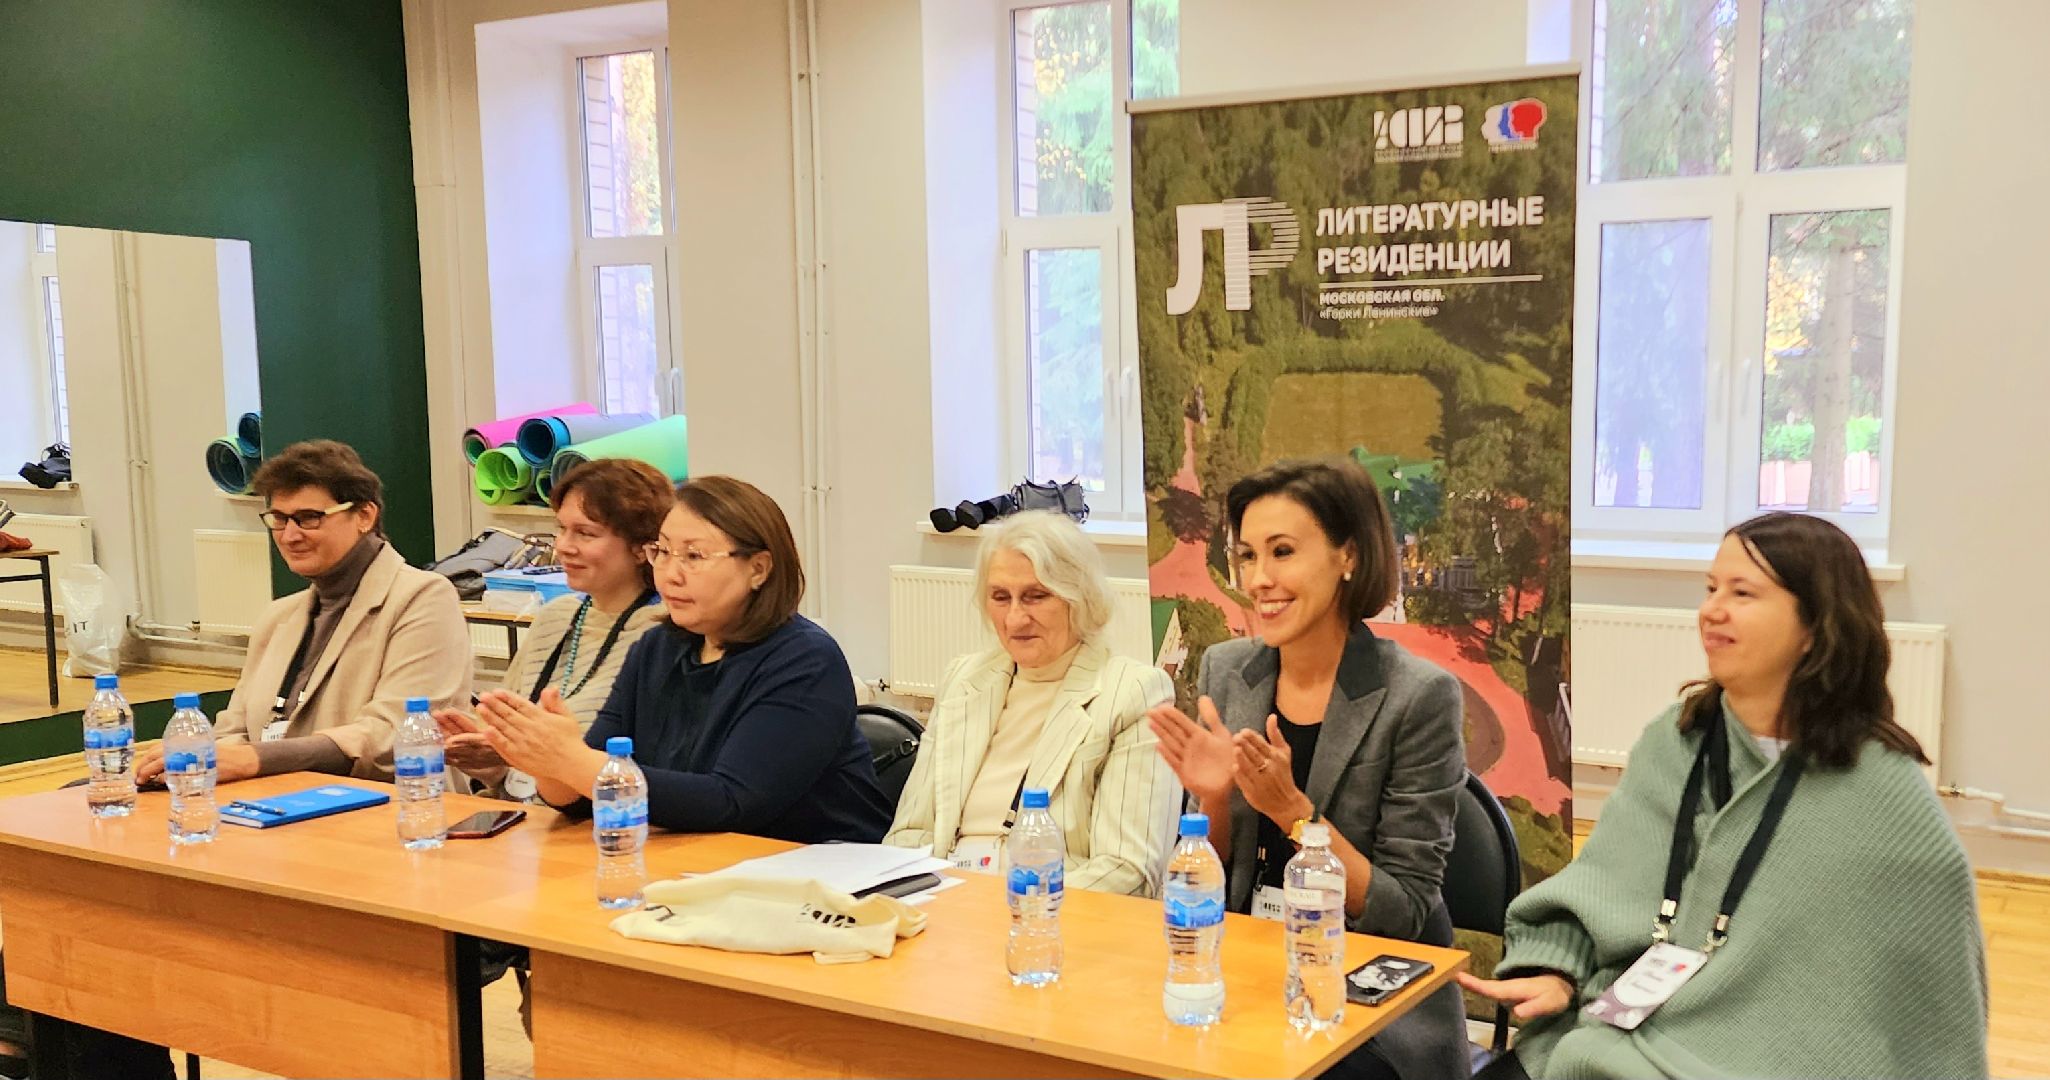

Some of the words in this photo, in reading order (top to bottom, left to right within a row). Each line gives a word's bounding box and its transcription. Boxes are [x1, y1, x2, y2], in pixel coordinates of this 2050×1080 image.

[1315, 195, 1545, 237] ЛИТЕРАТУРНЫЕ
[1316, 238, 1512, 277] РЕЗИДЕНЦИИ
[1319, 289, 1412, 306] МОСКОВСКАЯ
[1412, 288, 1447, 303] ОБЛ.
